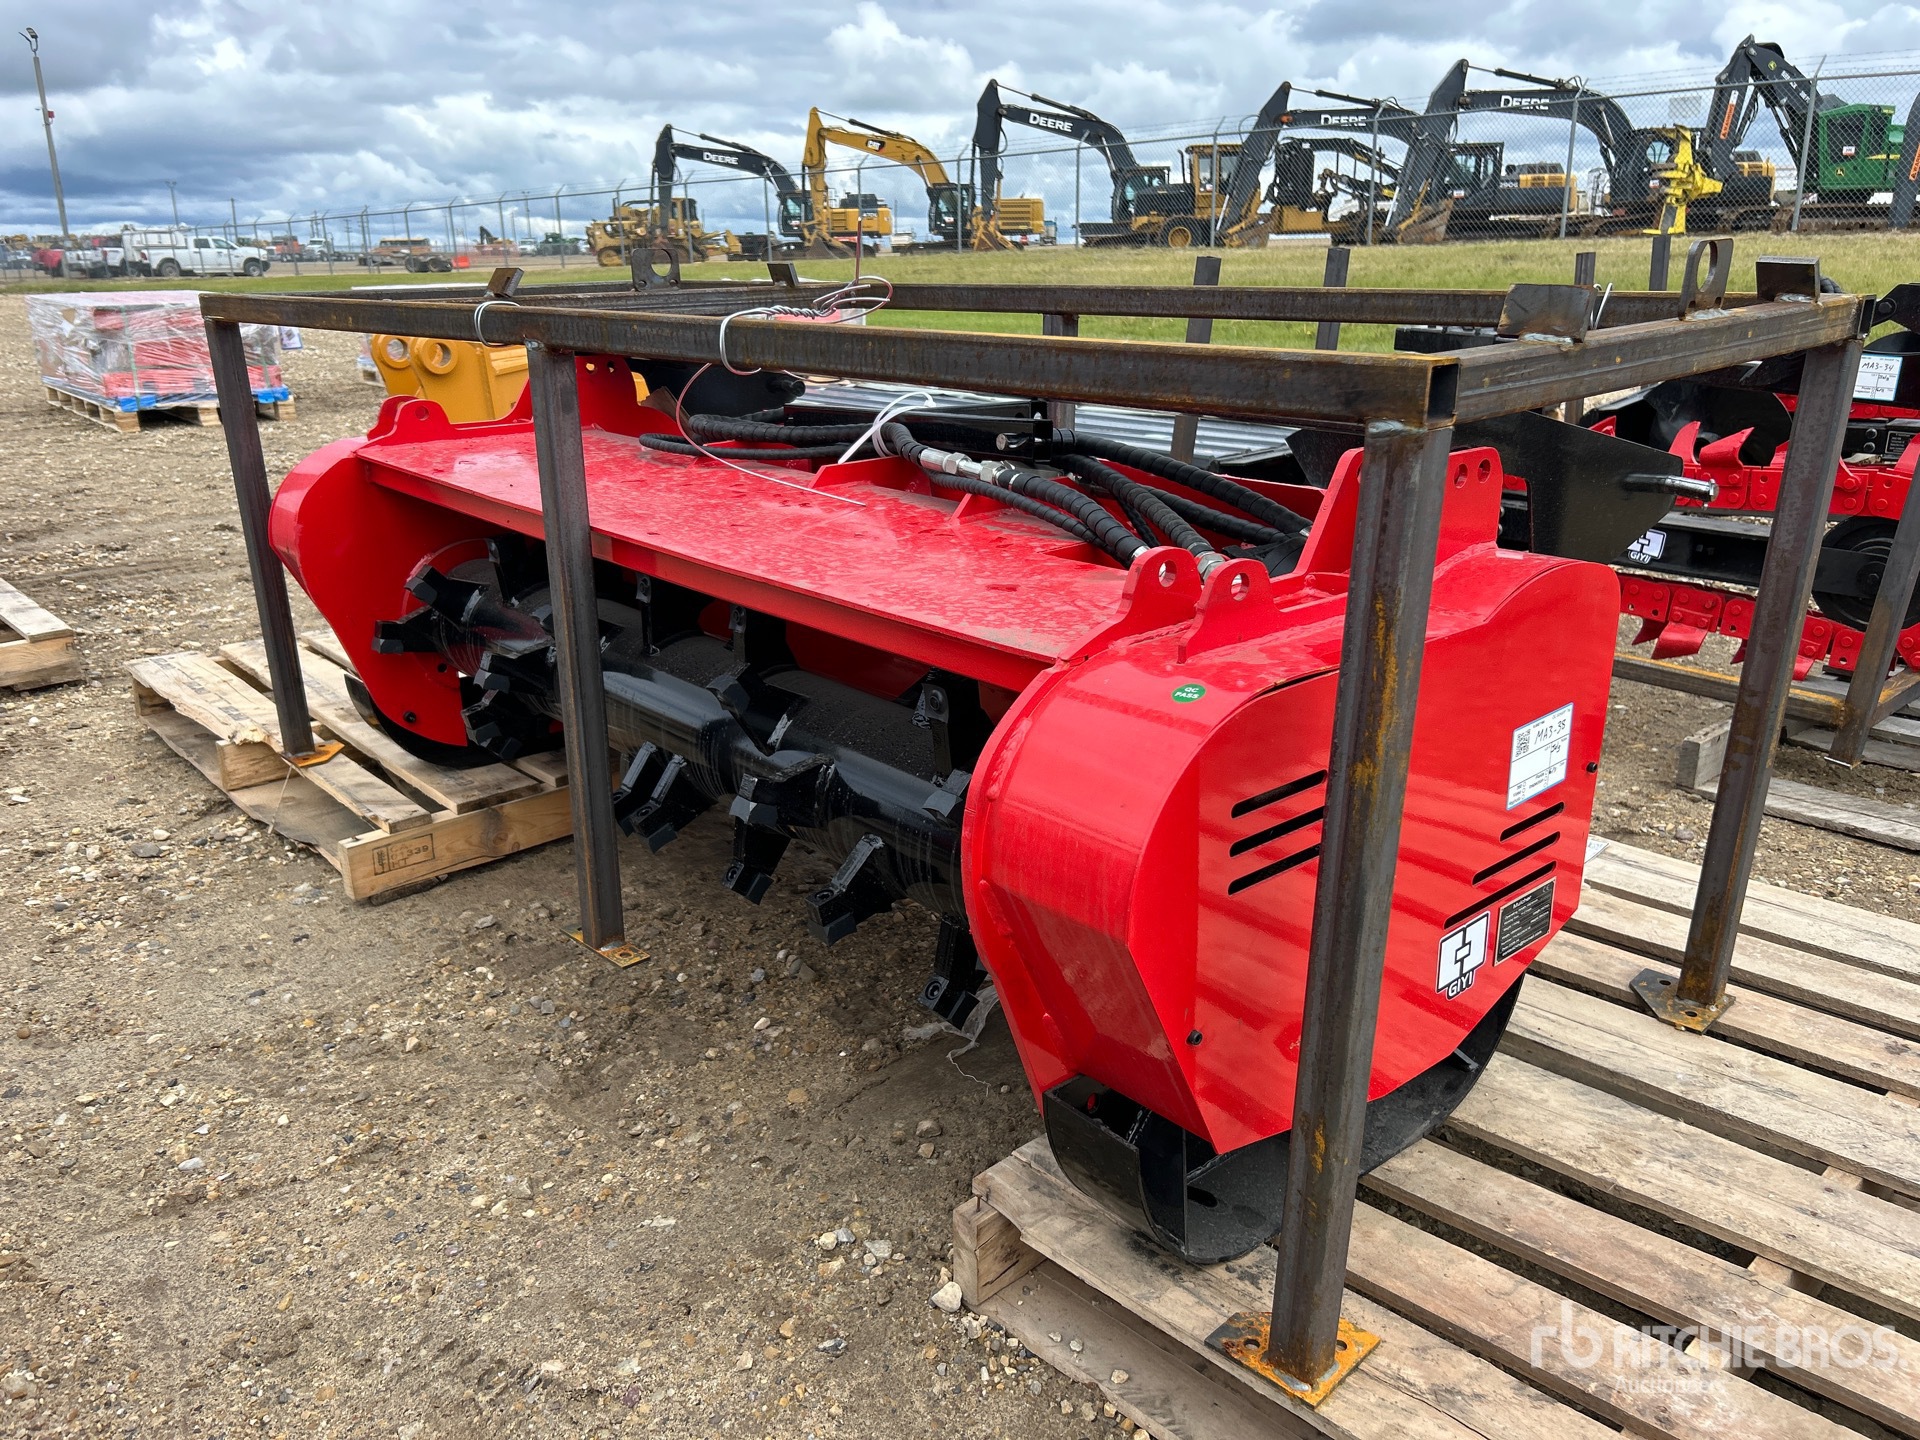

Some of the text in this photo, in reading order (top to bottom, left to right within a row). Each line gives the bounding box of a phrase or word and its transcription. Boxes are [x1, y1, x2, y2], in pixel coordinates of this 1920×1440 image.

[1500, 95, 1550, 110] DEERE
[1028, 112, 1074, 132] DEERE
[1320, 114, 1367, 127] DEERE
[702, 151, 739, 165] DEERE
[1861, 362, 1895, 372] MA3-34
[1630, 551, 1649, 562] GIYI
[1174, 691, 1200, 699] PASS
[1448, 971, 1473, 997] GIYI
